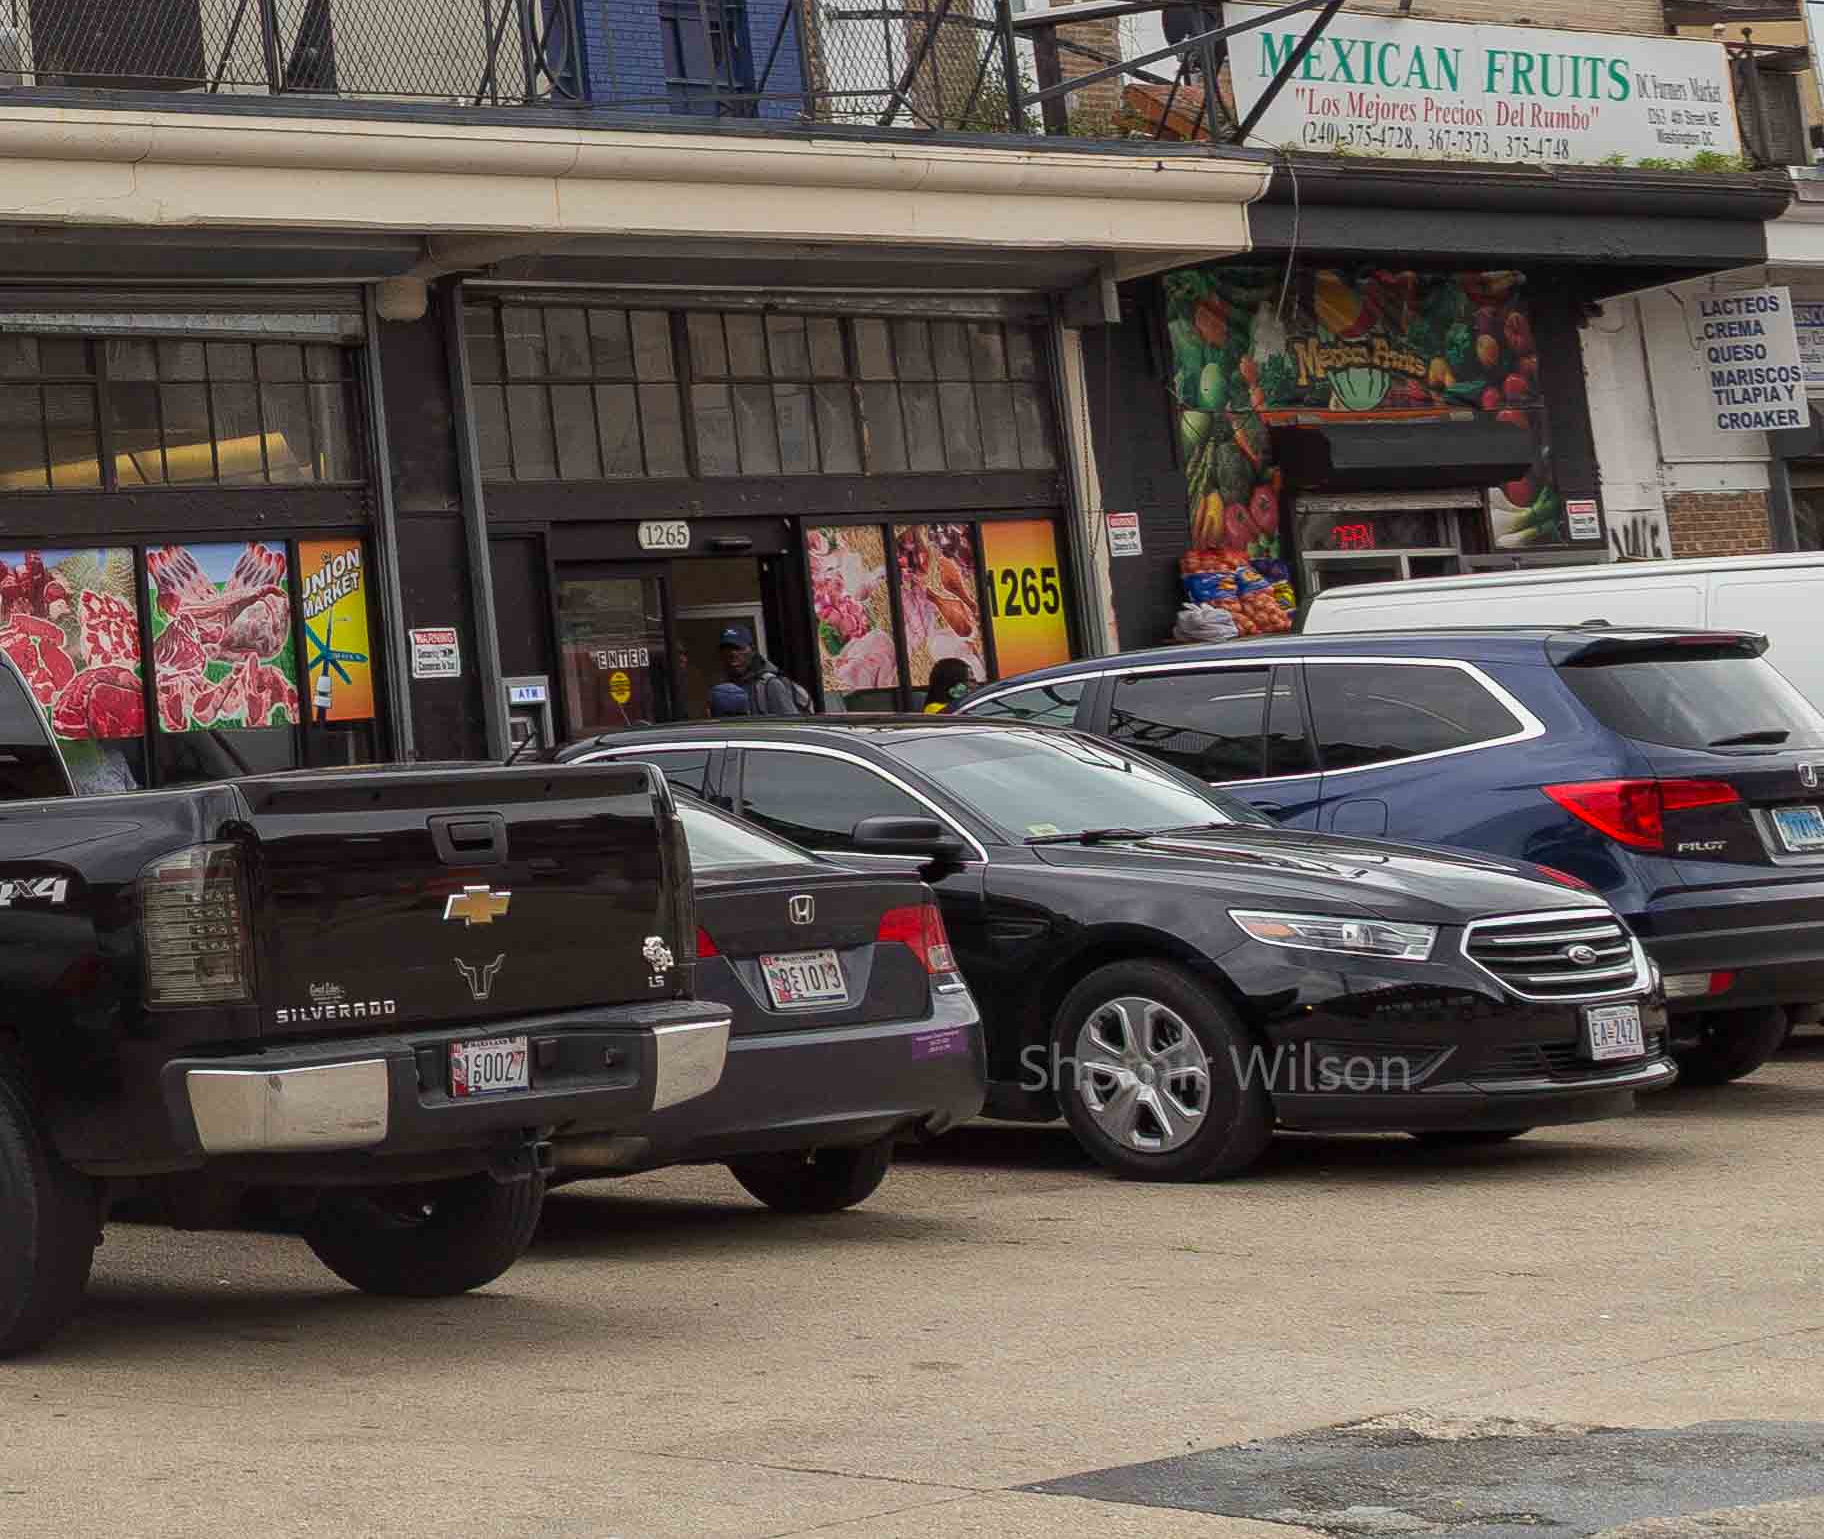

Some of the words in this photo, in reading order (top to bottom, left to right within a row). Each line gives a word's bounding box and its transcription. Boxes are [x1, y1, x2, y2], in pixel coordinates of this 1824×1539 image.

[1257, 32, 1464, 92] MEXICAN
[1482, 49, 1631, 102] FRUITS
[1295, 87, 1340, 117] "Los
[1345, 91, 1417, 126] Mejores
[1423, 97, 1483, 126] Precios
[1495, 100, 1525, 128] Del
[1530, 102, 1599, 131] Rumbo"
[1702, 295, 1780, 318] LACTEOS
[1704, 319, 1765, 340] CREMA
[1707, 344, 1767, 364] QUESO
[1712, 366, 1802, 387] MARISCOS
[1713, 386, 1782, 406] TILAPIA
[1784, 385, 1795, 402] Y
[1717, 409, 1801, 430] CROAKER
[645, 524, 687, 546] 1265
[303, 572, 360, 620] MARKET
[986, 567, 1060, 618] 1265
[597, 648, 649, 669] ENTER
[518, 688, 539, 699] ATM
[276, 999, 396, 1023] SILVERADO
